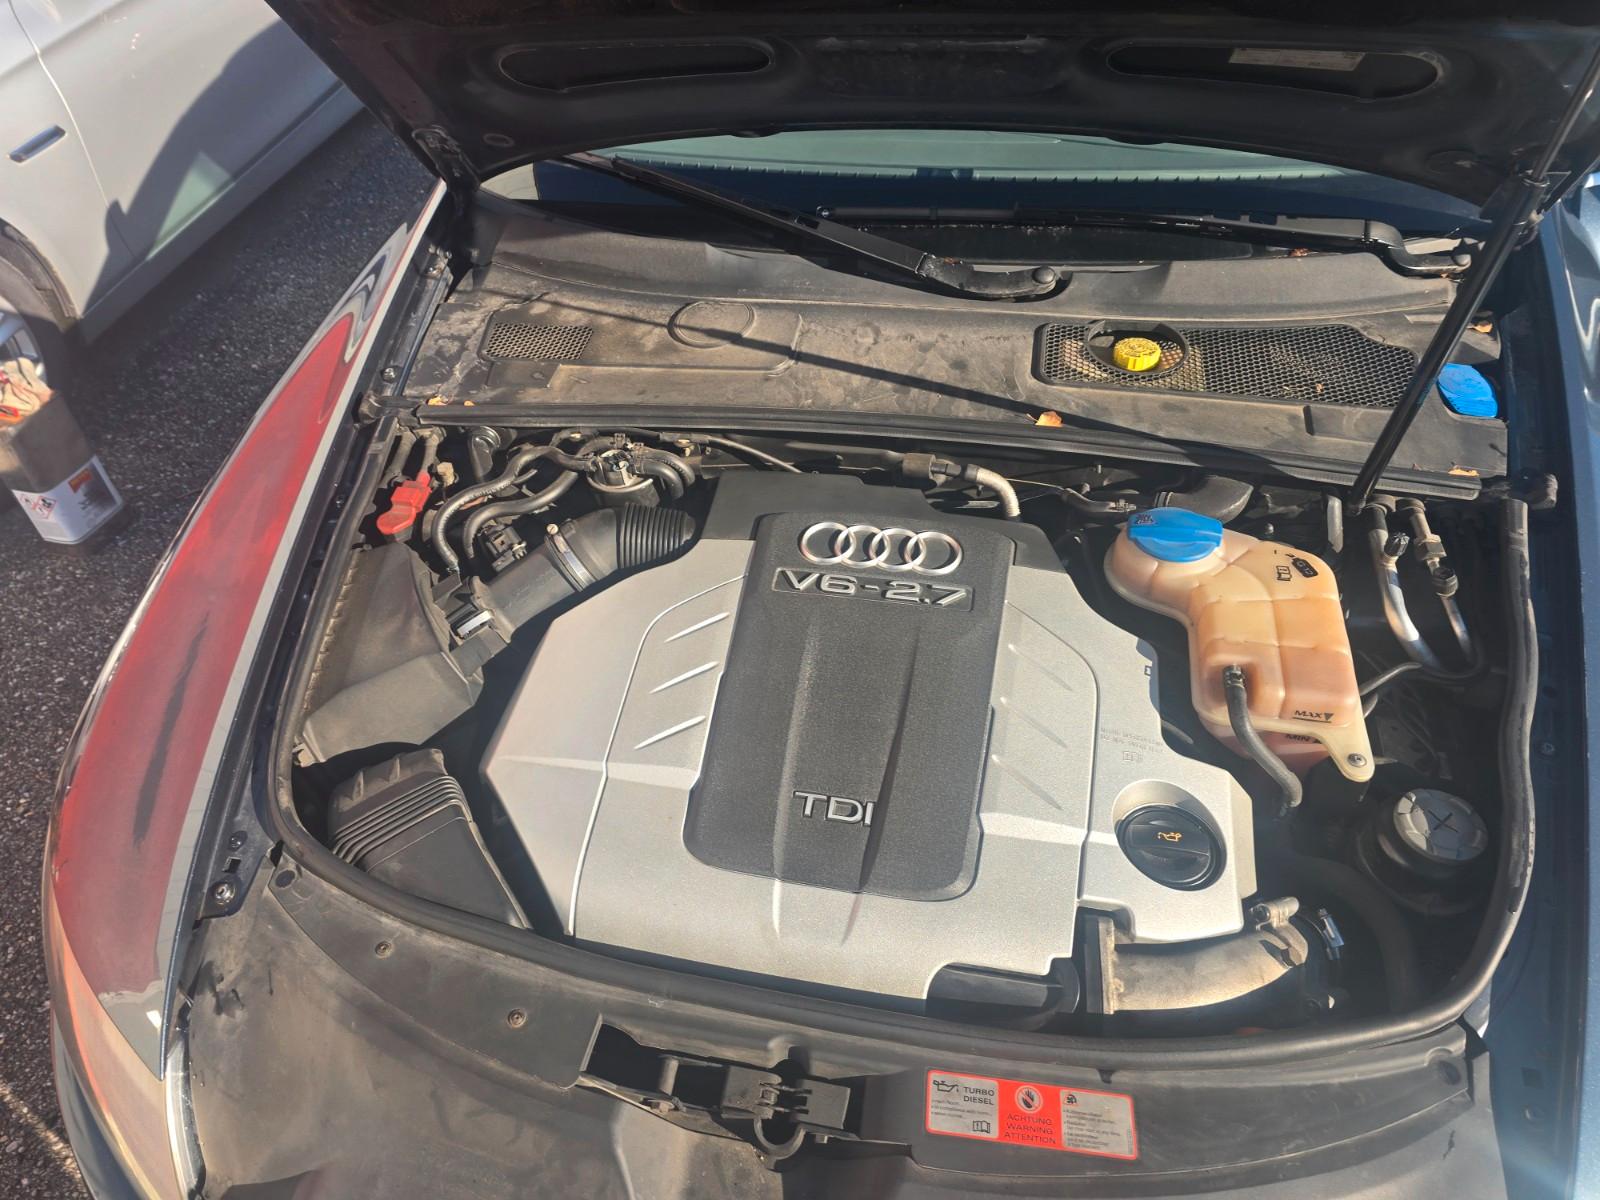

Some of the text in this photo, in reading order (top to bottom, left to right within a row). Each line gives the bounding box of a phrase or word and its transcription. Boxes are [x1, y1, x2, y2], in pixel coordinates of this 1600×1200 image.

[793, 791, 874, 826] TDI
[963, 1086, 995, 1097] TURBO
[963, 1095, 995, 1106] DIESEL
[1007, 1113, 1053, 1126] ACHTUNG
[1006, 1122, 1053, 1135] WARNING
[1004, 1131, 1057, 1145] ATTENTION
